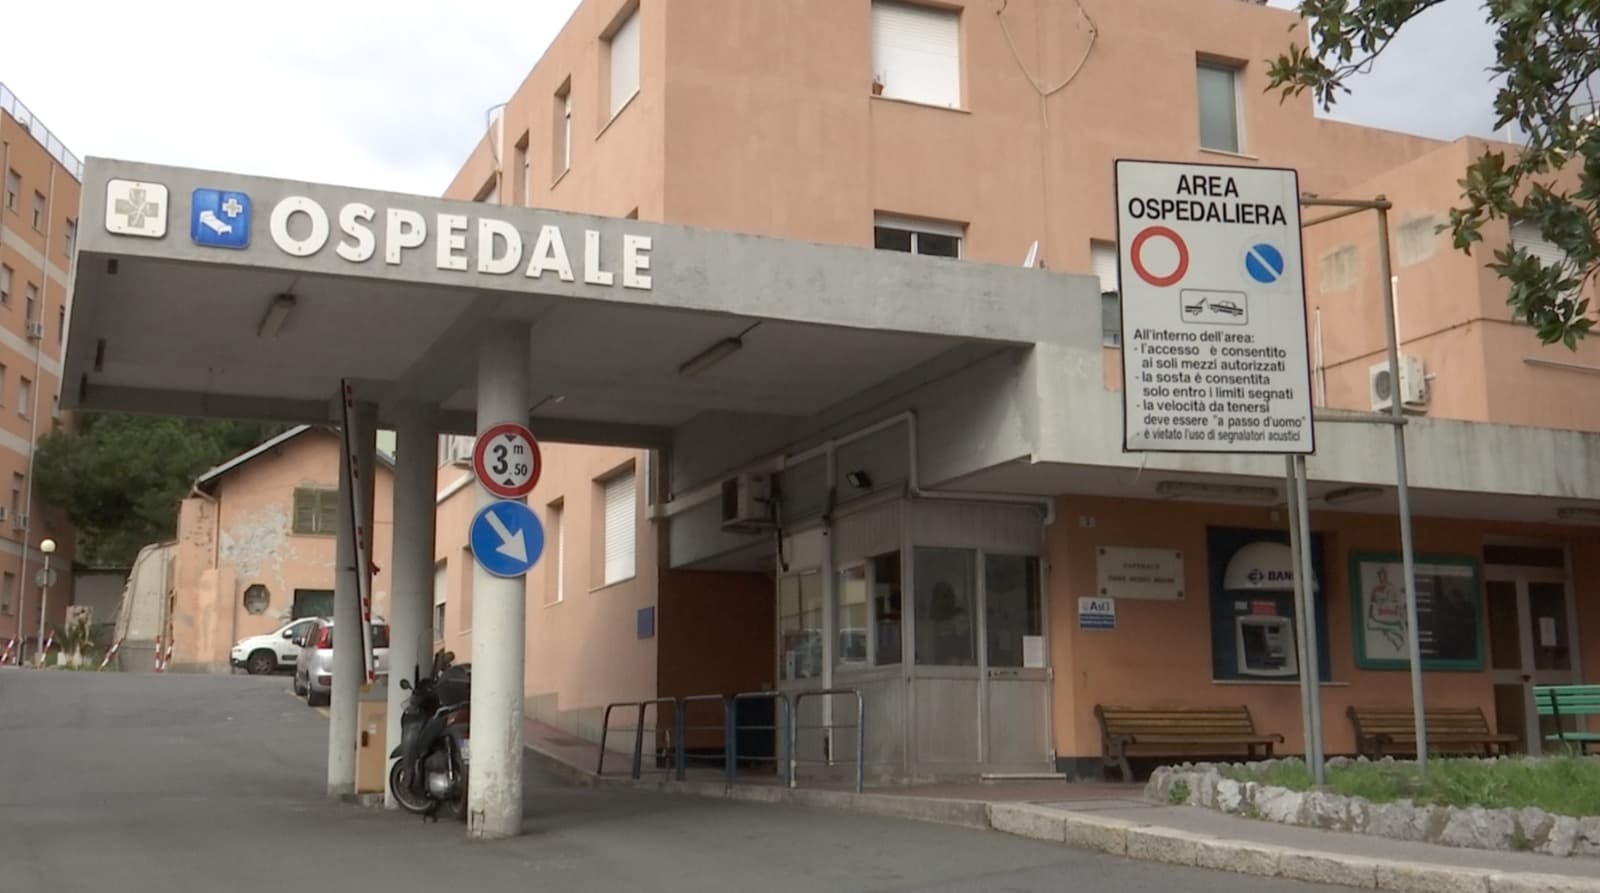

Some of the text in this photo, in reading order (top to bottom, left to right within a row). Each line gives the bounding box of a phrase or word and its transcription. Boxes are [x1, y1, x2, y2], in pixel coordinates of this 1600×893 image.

[1176, 174, 1239, 198] AREA
[1128, 197, 1287, 226] OSPEDALIERA
[270, 195, 653, 290] OSPEDALE
[1133, 329, 1255, 343] All'interno dell'area:
[1140, 343, 1200, 355] l'accesso
[1209, 345, 1218, 356] è
[1221, 346, 1287, 358] consentito
[1142, 356, 1285, 372] ai soli mezzi autorizzati
[1142, 371, 1153, 383] la
[1156, 373, 1191, 384] sosta
[1194, 373, 1203, 384] è
[1205, 374, 1270, 385] consentita
[1143, 386, 1170, 397] solo
[1172, 387, 1206, 398] entro
[1215, 387, 1245, 399] limiti
[1248, 388, 1293, 402] segnati
[1143, 400, 1154, 411] la
[1157, 400, 1206, 412] velocità
[1208, 400, 1225, 412] da
[1227, 401, 1270, 413] tenersi
[1143, 414, 1170, 425] deve
[1172, 415, 1208, 426] essere
[1228, 417, 1260, 428] passo
[1152, 429, 1182, 440] vietato
[1184, 429, 1206, 440] l'uso
[1207, 429, 1215, 440] di
[1217, 430, 1265, 443] segnalatori
[1268, 430, 1300, 441] acustici
[513, 444, 524, 455] m
